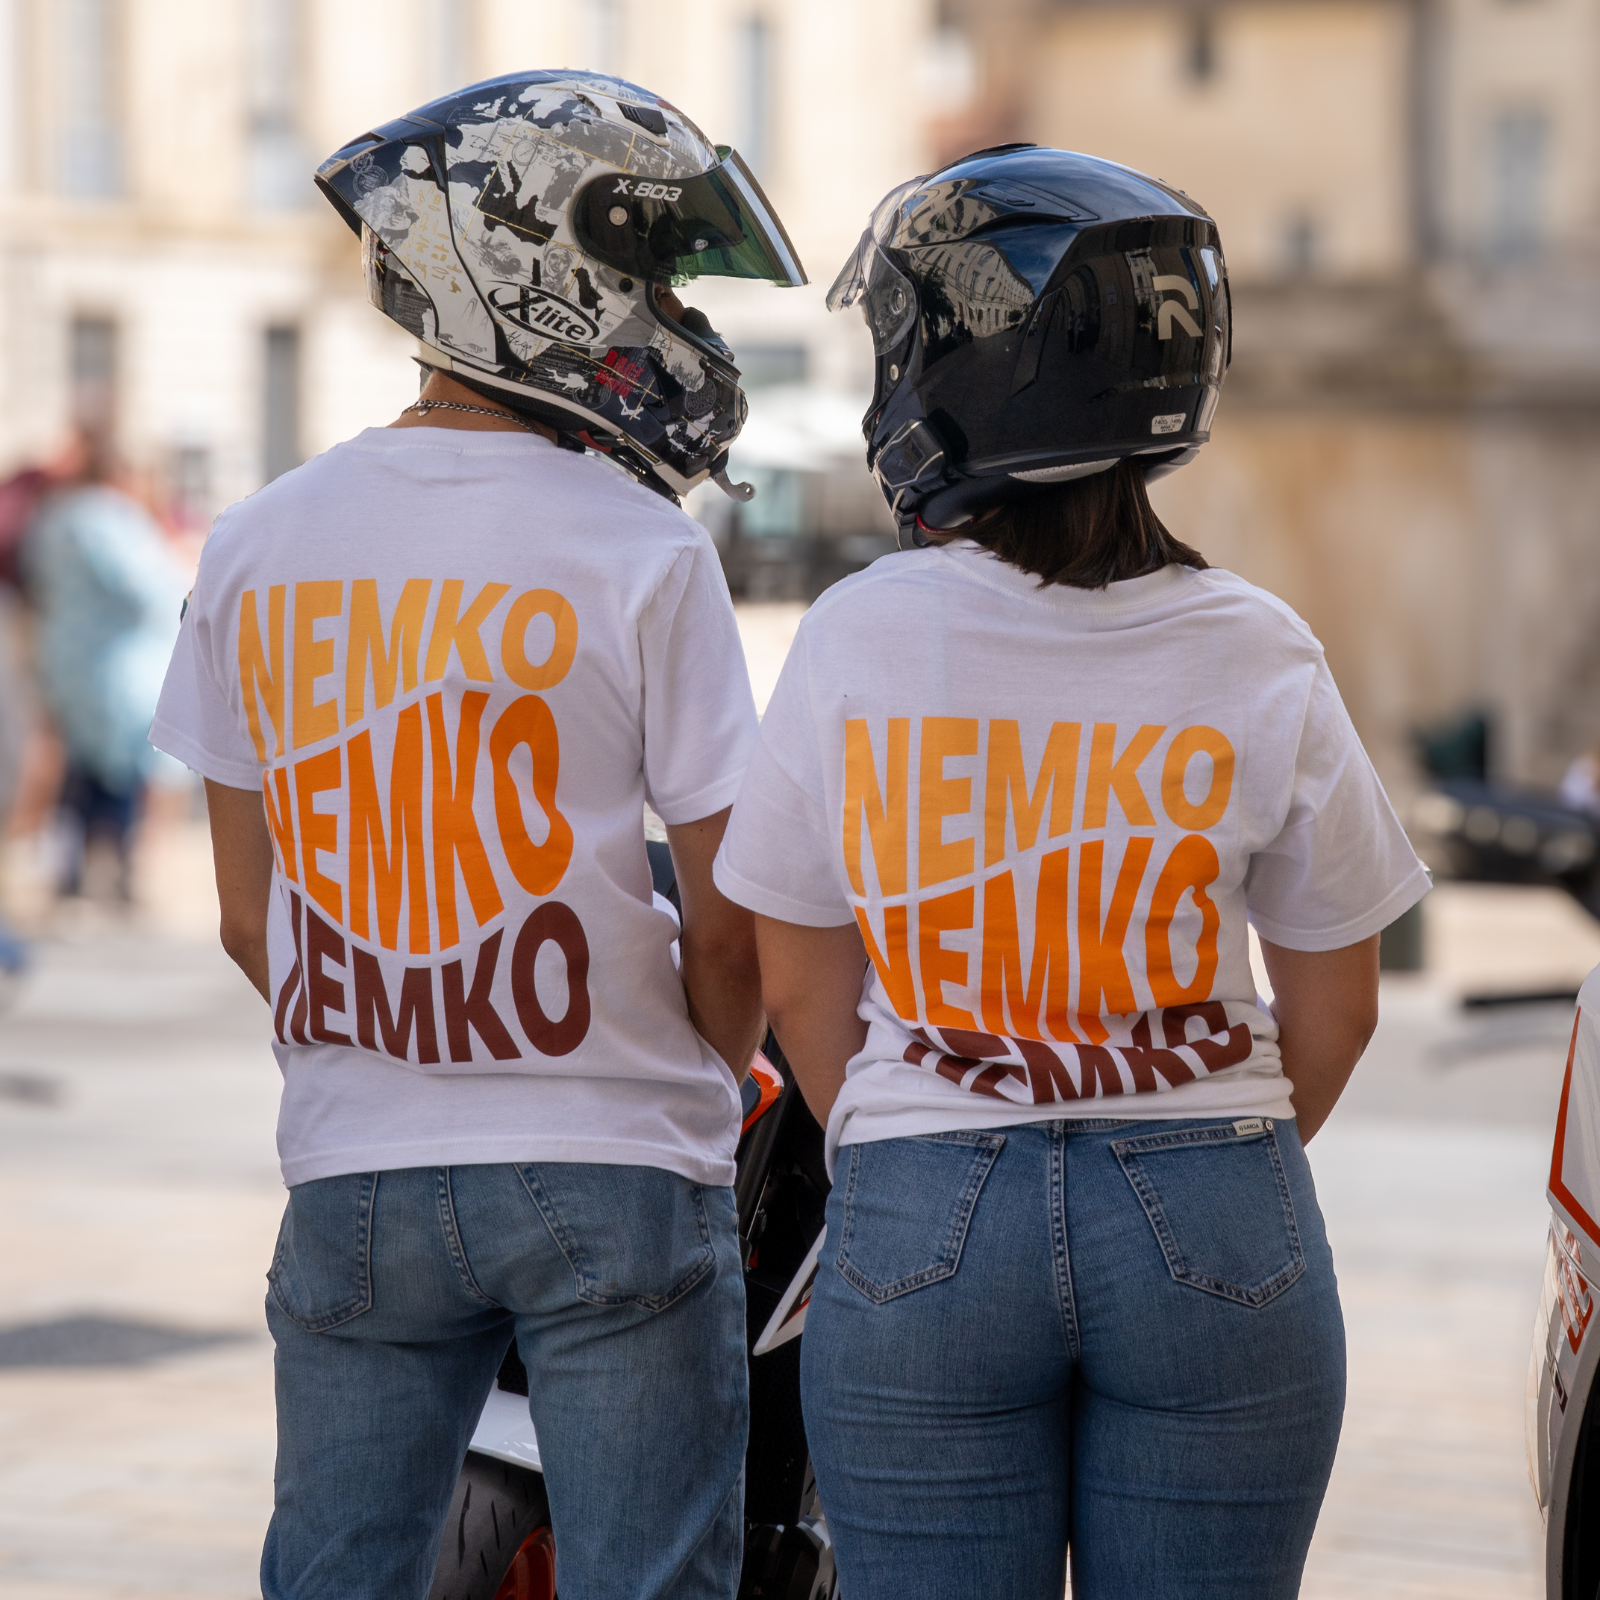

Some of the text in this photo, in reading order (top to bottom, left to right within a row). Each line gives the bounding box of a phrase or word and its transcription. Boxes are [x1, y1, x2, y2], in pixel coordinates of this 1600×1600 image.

[612, 178, 682, 202] X-803
[495, 285, 587, 341] X-lite
[238, 579, 578, 763] NEMKO
[262, 690, 574, 956] NEMKO
[843, 716, 1235, 898] NEMKO
[854, 834, 1220, 1046] NEMKO
